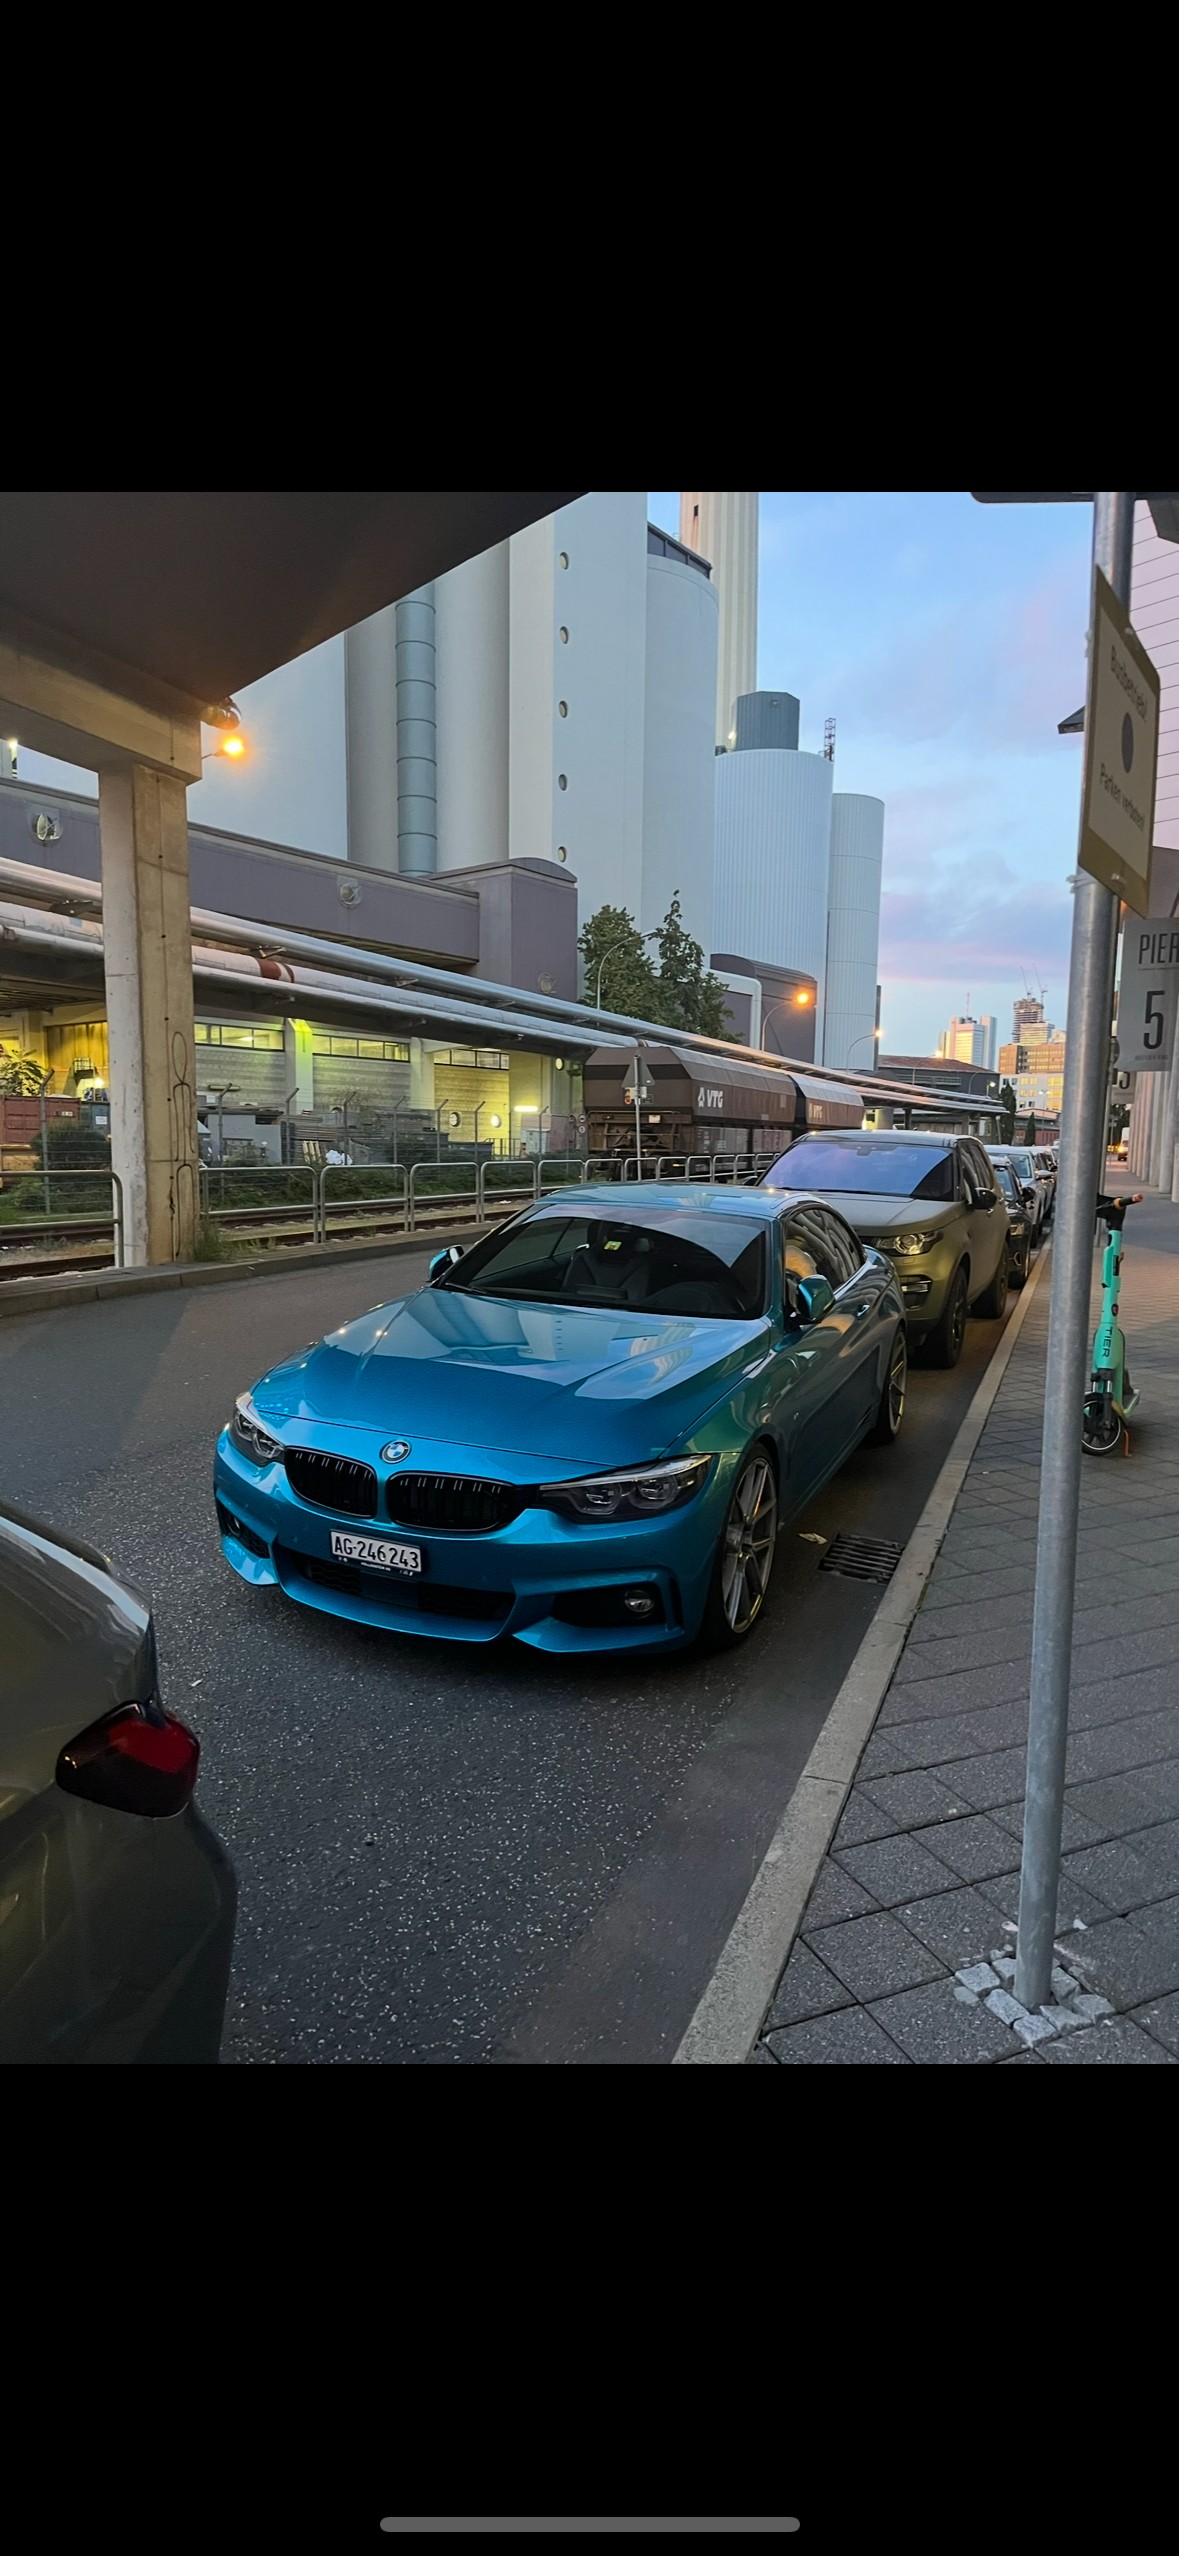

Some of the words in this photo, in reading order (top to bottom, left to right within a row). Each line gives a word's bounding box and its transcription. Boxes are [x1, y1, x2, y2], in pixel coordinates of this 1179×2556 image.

[1138, 932, 1179, 965] PIER
[1143, 990, 1165, 1049] 5
[706, 1088, 724, 1108] VTG
[1102, 1326, 1113, 1358] TIER
